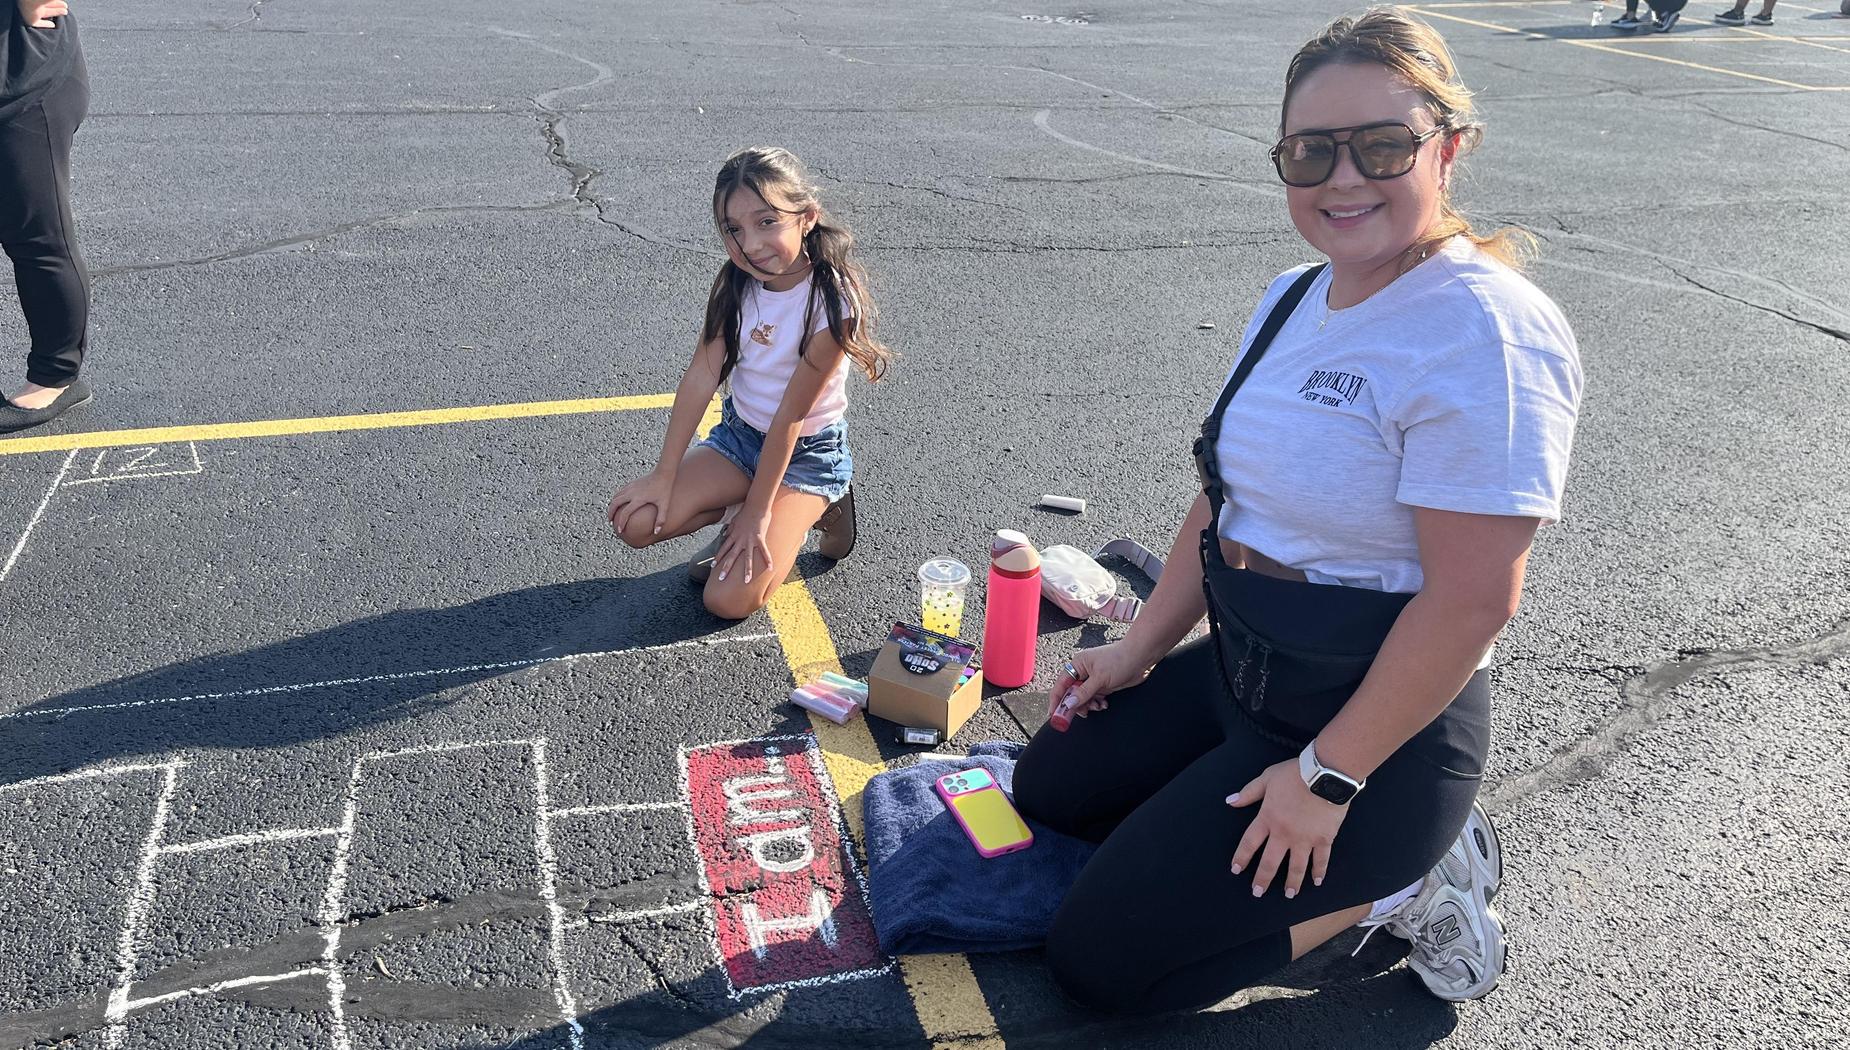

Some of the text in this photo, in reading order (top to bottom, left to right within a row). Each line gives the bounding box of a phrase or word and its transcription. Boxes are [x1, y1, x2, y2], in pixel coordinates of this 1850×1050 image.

[1297, 370, 1367, 406] BROOKLYN
[1303, 391, 1343, 407] NEW YORK
[741, 888, 838, 961] I
[1431, 914, 1461, 945] N
